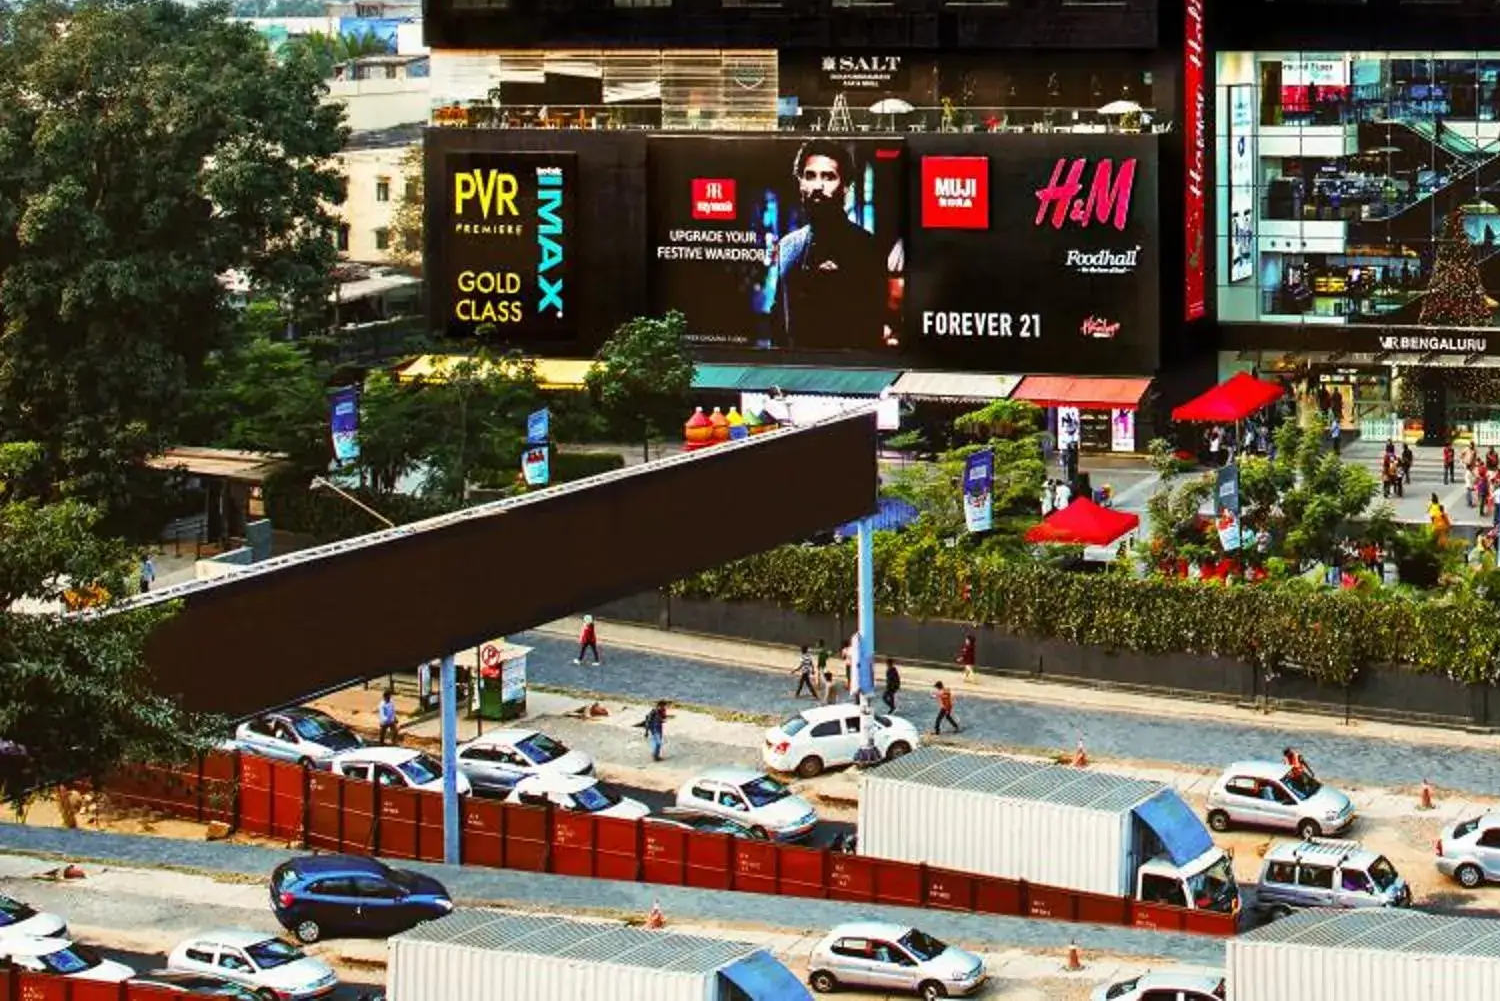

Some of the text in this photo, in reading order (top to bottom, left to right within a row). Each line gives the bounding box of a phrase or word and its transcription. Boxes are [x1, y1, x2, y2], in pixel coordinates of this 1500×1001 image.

[839, 55, 901, 72] SALT
[455, 168, 519, 219] PVR
[935, 177, 977, 198] MUJI
[1035, 157, 1137, 231] H&M
[537, 175, 564, 312] IMAX
[669, 230, 757, 243] UPGRADE YOUR
[657, 246, 772, 262] FESTIVE WARDROBE
[1065, 249, 1137, 266] Foodhall
[458, 270, 521, 295] GOLD
[455, 299, 523, 323] CLASS
[922, 311, 1041, 338] FOREVER 21
[1401, 336, 1487, 351] BENGALURU
